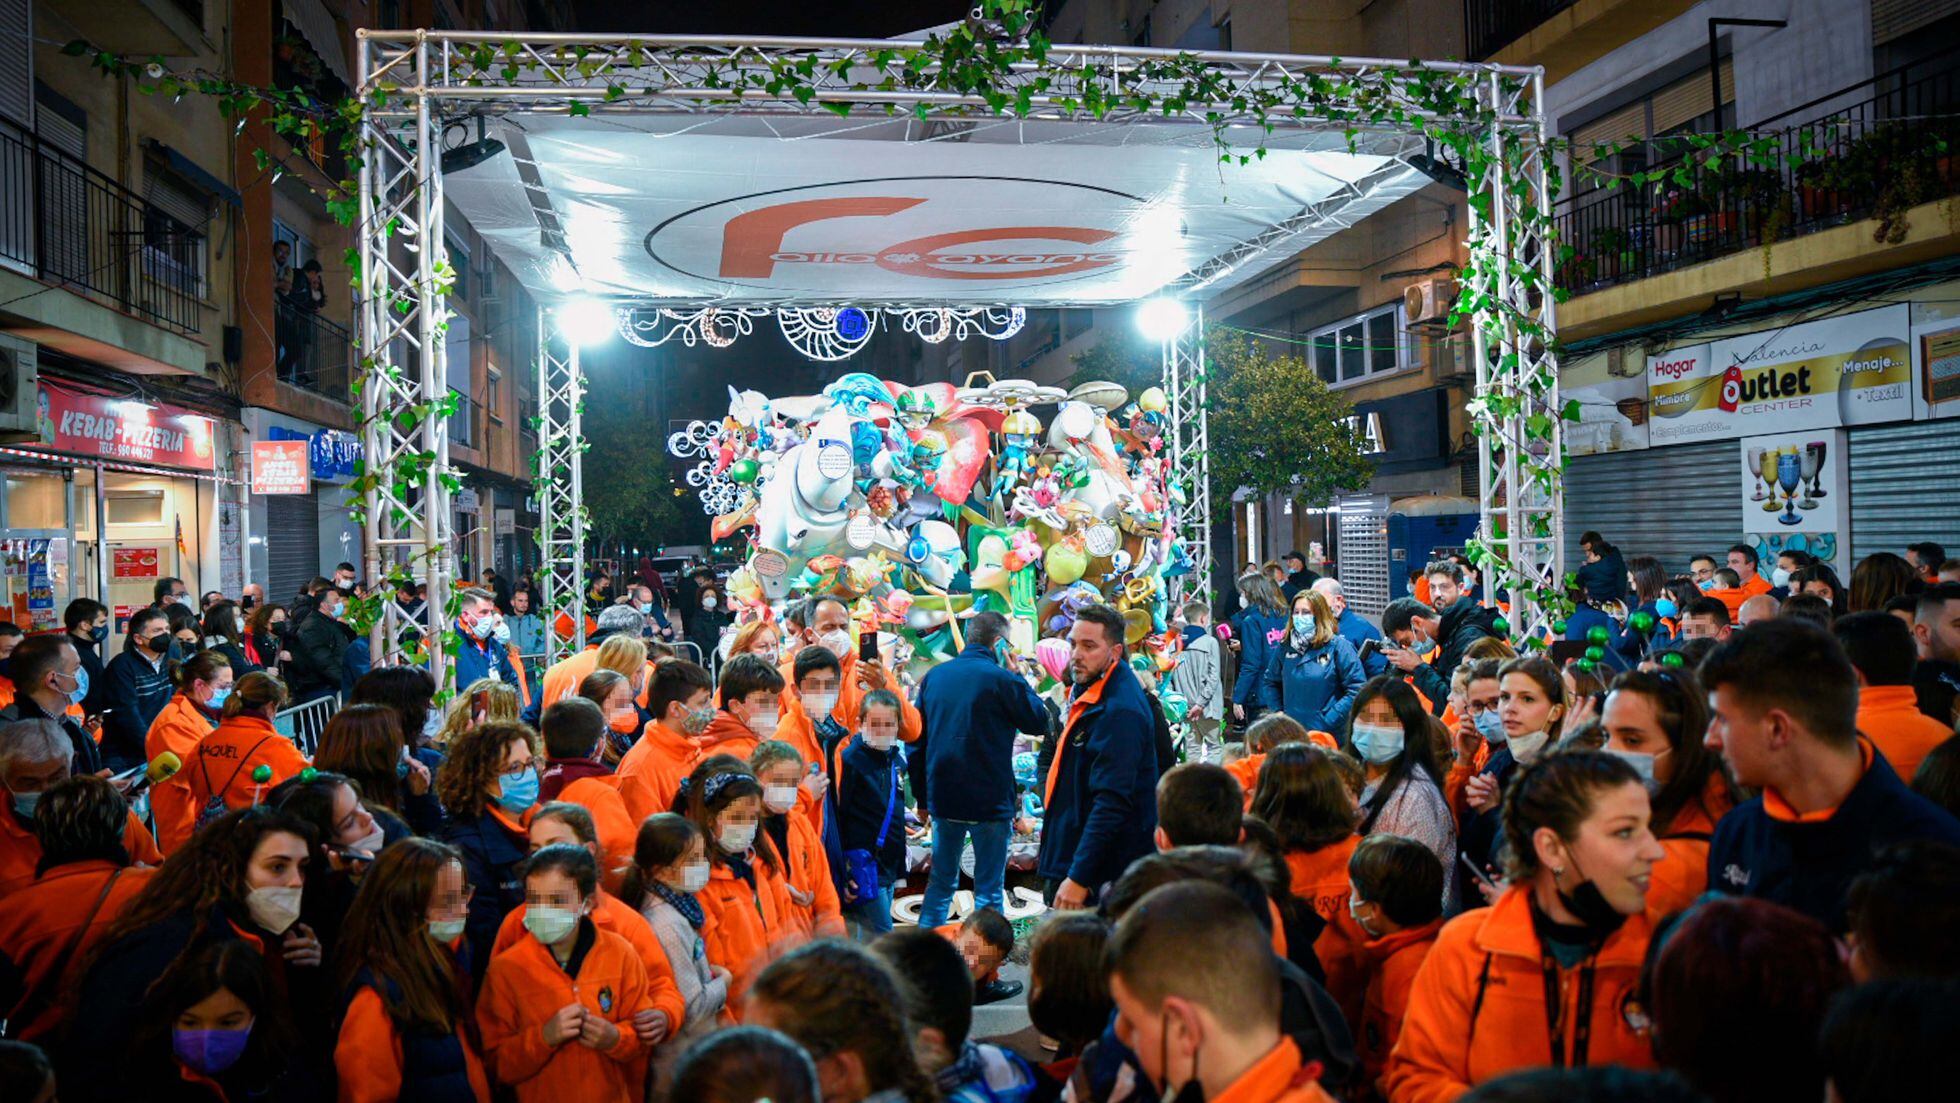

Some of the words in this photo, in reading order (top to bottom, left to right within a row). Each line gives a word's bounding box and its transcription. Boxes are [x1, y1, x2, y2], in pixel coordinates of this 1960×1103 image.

[1732, 342, 1826, 364] Valencia
[1655, 359, 1696, 379] Hogar
[1723, 365, 1811, 404] Outlet
[1864, 384, 1904, 402] Textil
[1655, 391, 1691, 406] Mimbre
[1740, 399, 1813, 415] CENTER
